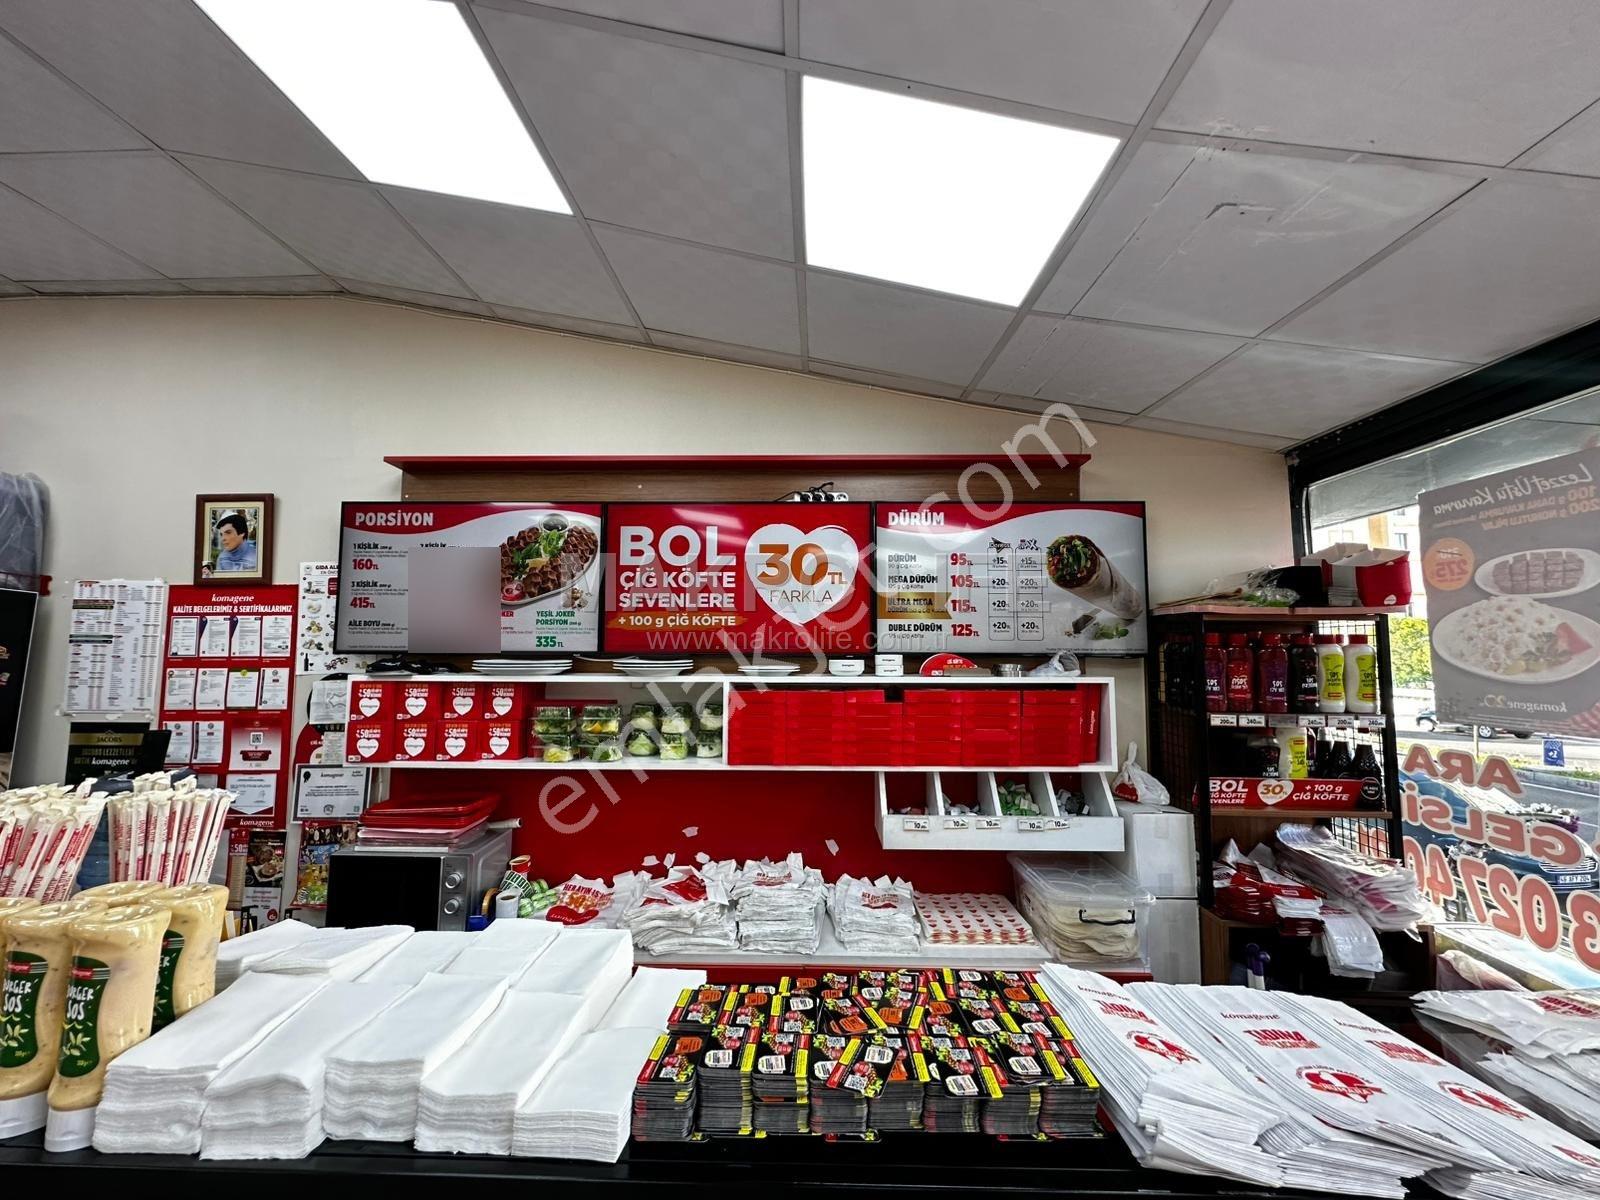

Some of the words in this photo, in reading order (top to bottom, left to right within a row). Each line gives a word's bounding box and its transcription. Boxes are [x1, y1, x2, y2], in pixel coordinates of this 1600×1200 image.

[355, 510, 434, 526] PORSİYON
[888, 510, 944, 526] DÜRÜM
[620, 525, 736, 566] BOL
[888, 554, 916, 562] DÜRÜM
[620, 568, 657, 590] ÇİĞ
[662, 567, 736, 588] KÖFTE
[888, 575, 908, 583] MEGA
[909, 574, 938, 583] DÜRÜM
[211, 594, 254, 604] komagene
[619, 593, 735, 608] SEVENLERE
[770, 590, 833, 603] FARKLA
[173, 605, 192, 613] KALİTE
[193, 605, 232, 613] BELGELERİMİZ
[233, 605, 238, 613] &
[536, 609, 554, 618] YEŞİL
[536, 618, 569, 626] PORSİYON
[629, 615, 652, 626] 100
[655, 617, 664, 628] g
[667, 613, 689, 628] ÇİĞ
[692, 613, 736, 626] KÖFTE
[888, 624, 912, 632] DUBLE
[913, 623, 943, 632] DÜRÜM
[536, 636, 557, 647] 335
[91, 757, 130, 767] komagene
[1209, 779, 1249, 793] BOL
[1292, 792, 1311, 801] ÇİĞ
[1313, 792, 1350, 801] KÖFTE
[239, 819, 274, 827] komagene
[67, 1000, 85, 1020] SOS
[1220, 1012, 1280, 1021] komagene
